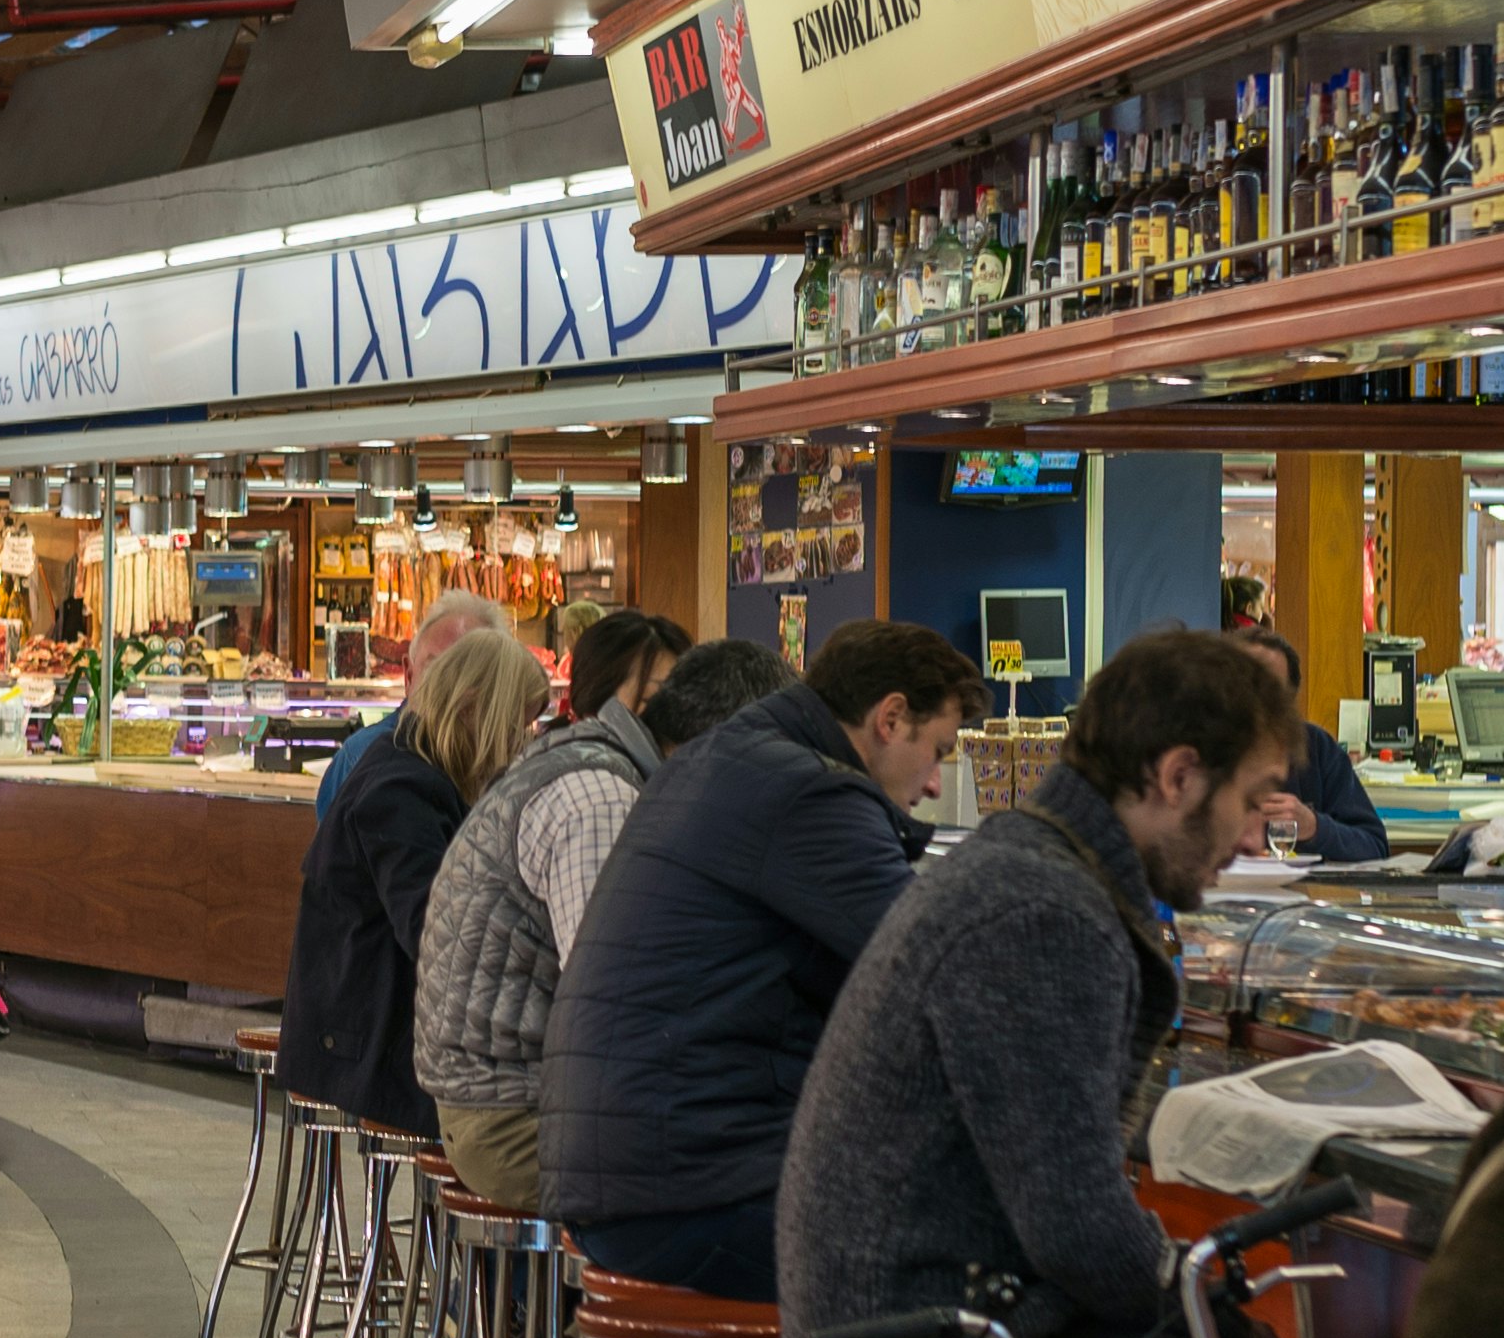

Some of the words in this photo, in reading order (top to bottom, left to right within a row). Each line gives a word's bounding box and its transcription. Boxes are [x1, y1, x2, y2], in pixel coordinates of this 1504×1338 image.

[647, 27, 708, 110] BAR
[662, 117, 723, 183] Joan
[19, 302, 119, 404] GABARRÓ
